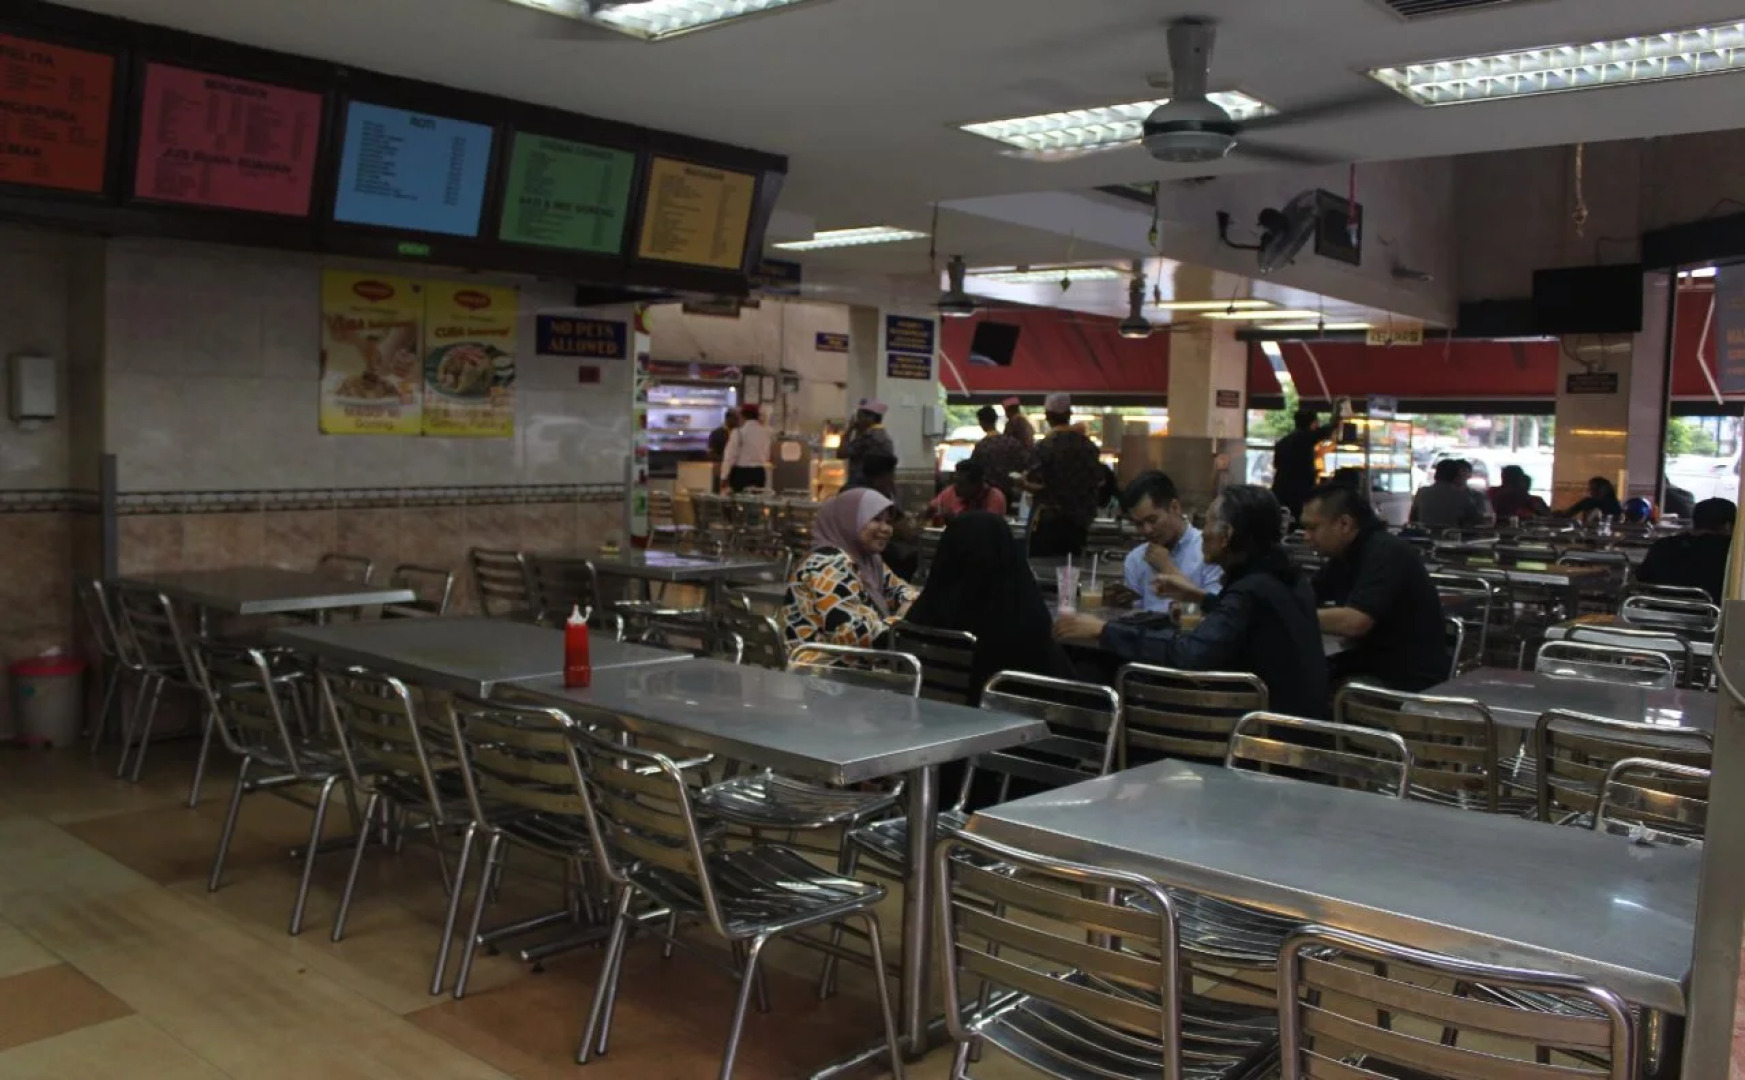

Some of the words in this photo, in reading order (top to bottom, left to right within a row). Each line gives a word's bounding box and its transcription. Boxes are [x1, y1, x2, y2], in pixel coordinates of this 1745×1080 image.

[409, 117, 436, 130] ROTI
[550, 320, 573, 335] NO
[575, 321, 614, 338] PETS
[549, 336, 619, 355] ALLOWED
